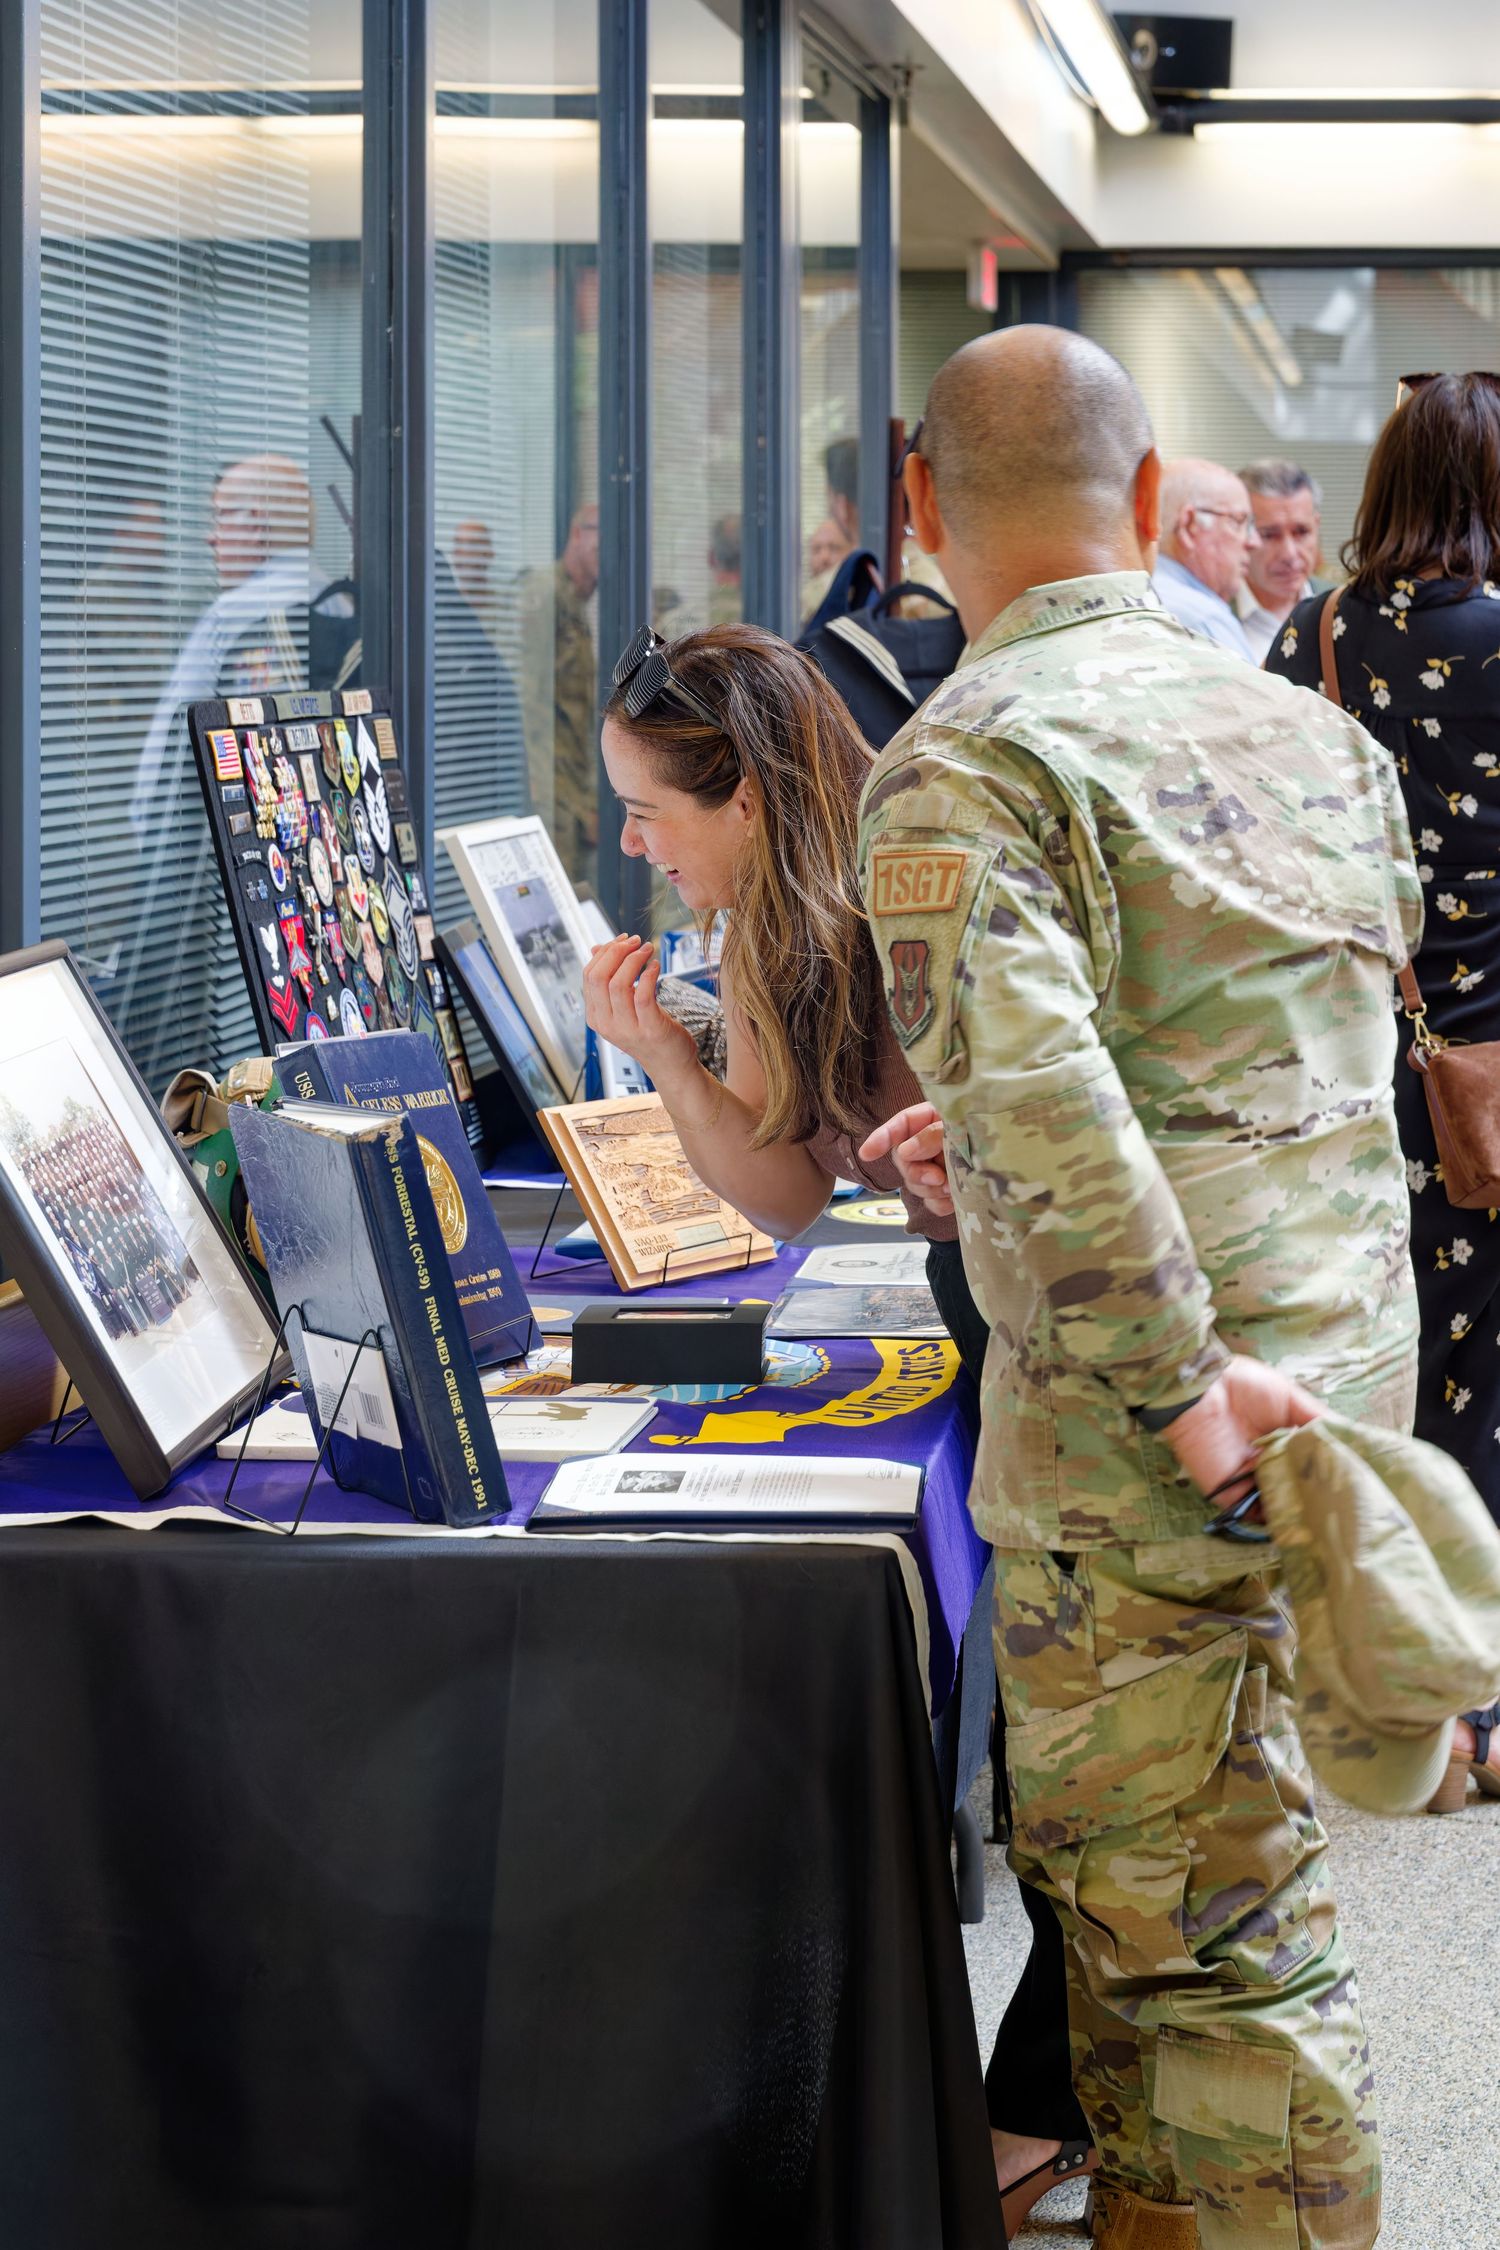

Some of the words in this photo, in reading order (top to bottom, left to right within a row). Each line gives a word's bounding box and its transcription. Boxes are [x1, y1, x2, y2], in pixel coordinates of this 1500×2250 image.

[879, 861, 960, 906] 1SGT
[295, 1071, 317, 1099] USS
[634, 1234, 668, 1247] VAQ-133
[391, 1166, 419, 1241] FORRESTAL
[409, 1242, 431, 1290] (CV-59)
[424, 1295, 442, 1335] FINAL
[435, 1336, 450, 1366] MED
[443, 1368, 464, 1416] CRUISE
[455, 1417, 479, 1475] MAY-DEC
[471, 1477, 488, 1510] 1991
